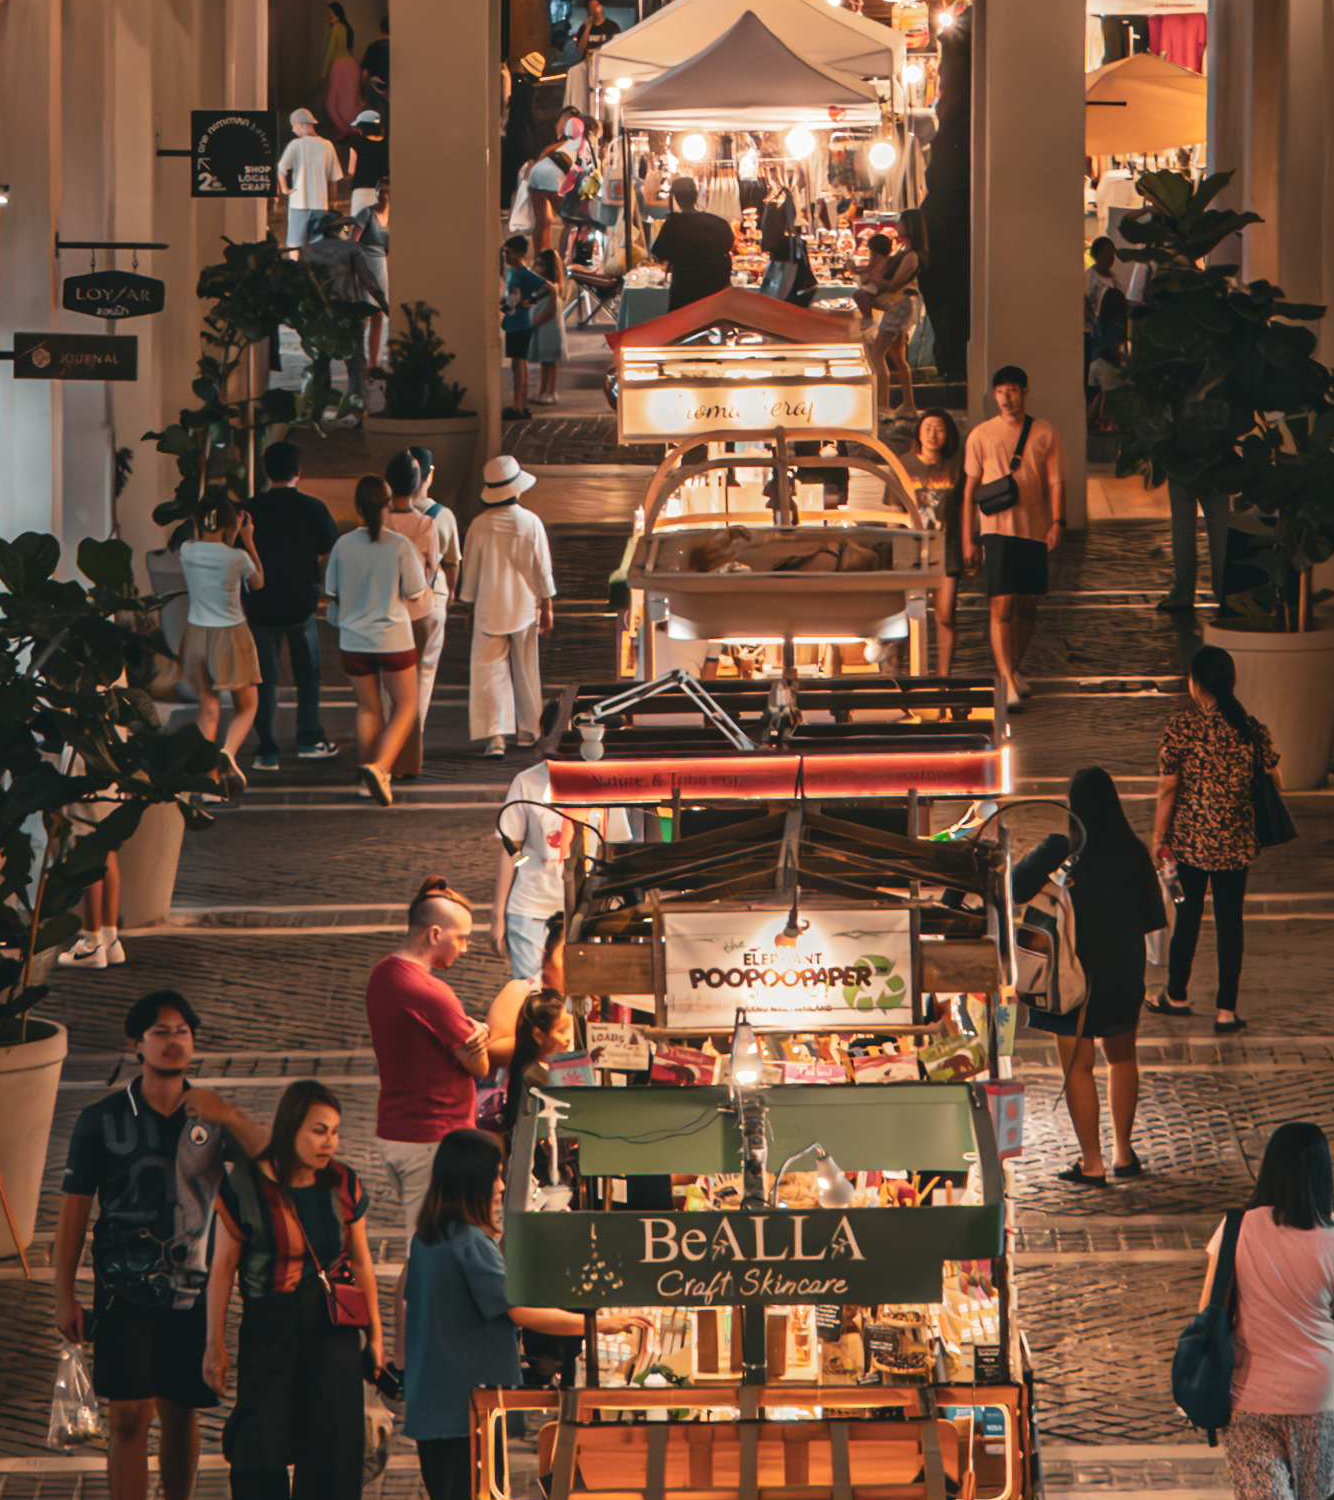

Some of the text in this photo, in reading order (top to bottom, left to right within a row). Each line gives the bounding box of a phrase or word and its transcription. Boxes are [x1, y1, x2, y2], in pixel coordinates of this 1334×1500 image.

[244, 165, 272, 174] SHOP
[238, 174, 271, 183] LOCAL
[240, 183, 272, 192] CRAFT
[59, 353, 119, 365] JOURNAL
[723, 938, 746, 954] the
[639, 1214, 867, 1264] BeALLA
[657, 1267, 849, 1305] Craft Skincare
